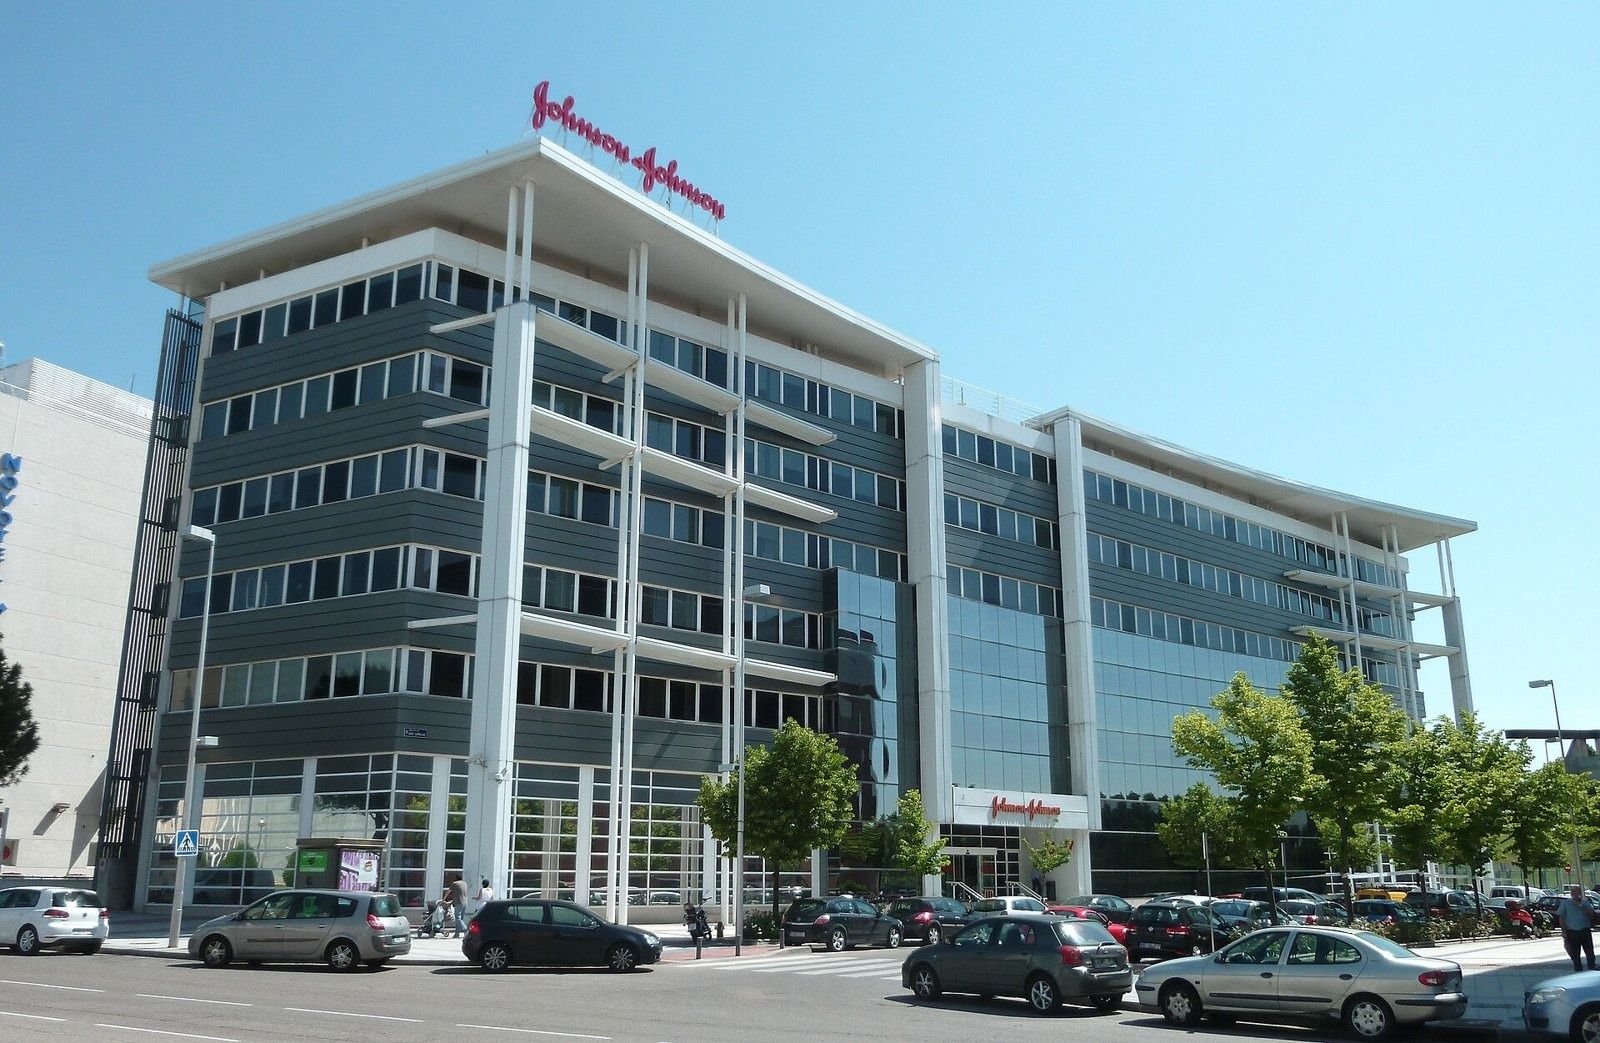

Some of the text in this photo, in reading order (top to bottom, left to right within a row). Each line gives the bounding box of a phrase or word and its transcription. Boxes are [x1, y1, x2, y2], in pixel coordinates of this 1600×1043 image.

[532, 80, 630, 164] Johnson
[642, 147, 726, 220] Johnson
[992, 795, 1025, 818] Johnson
[1029, 799, 1060, 821] Johnson
